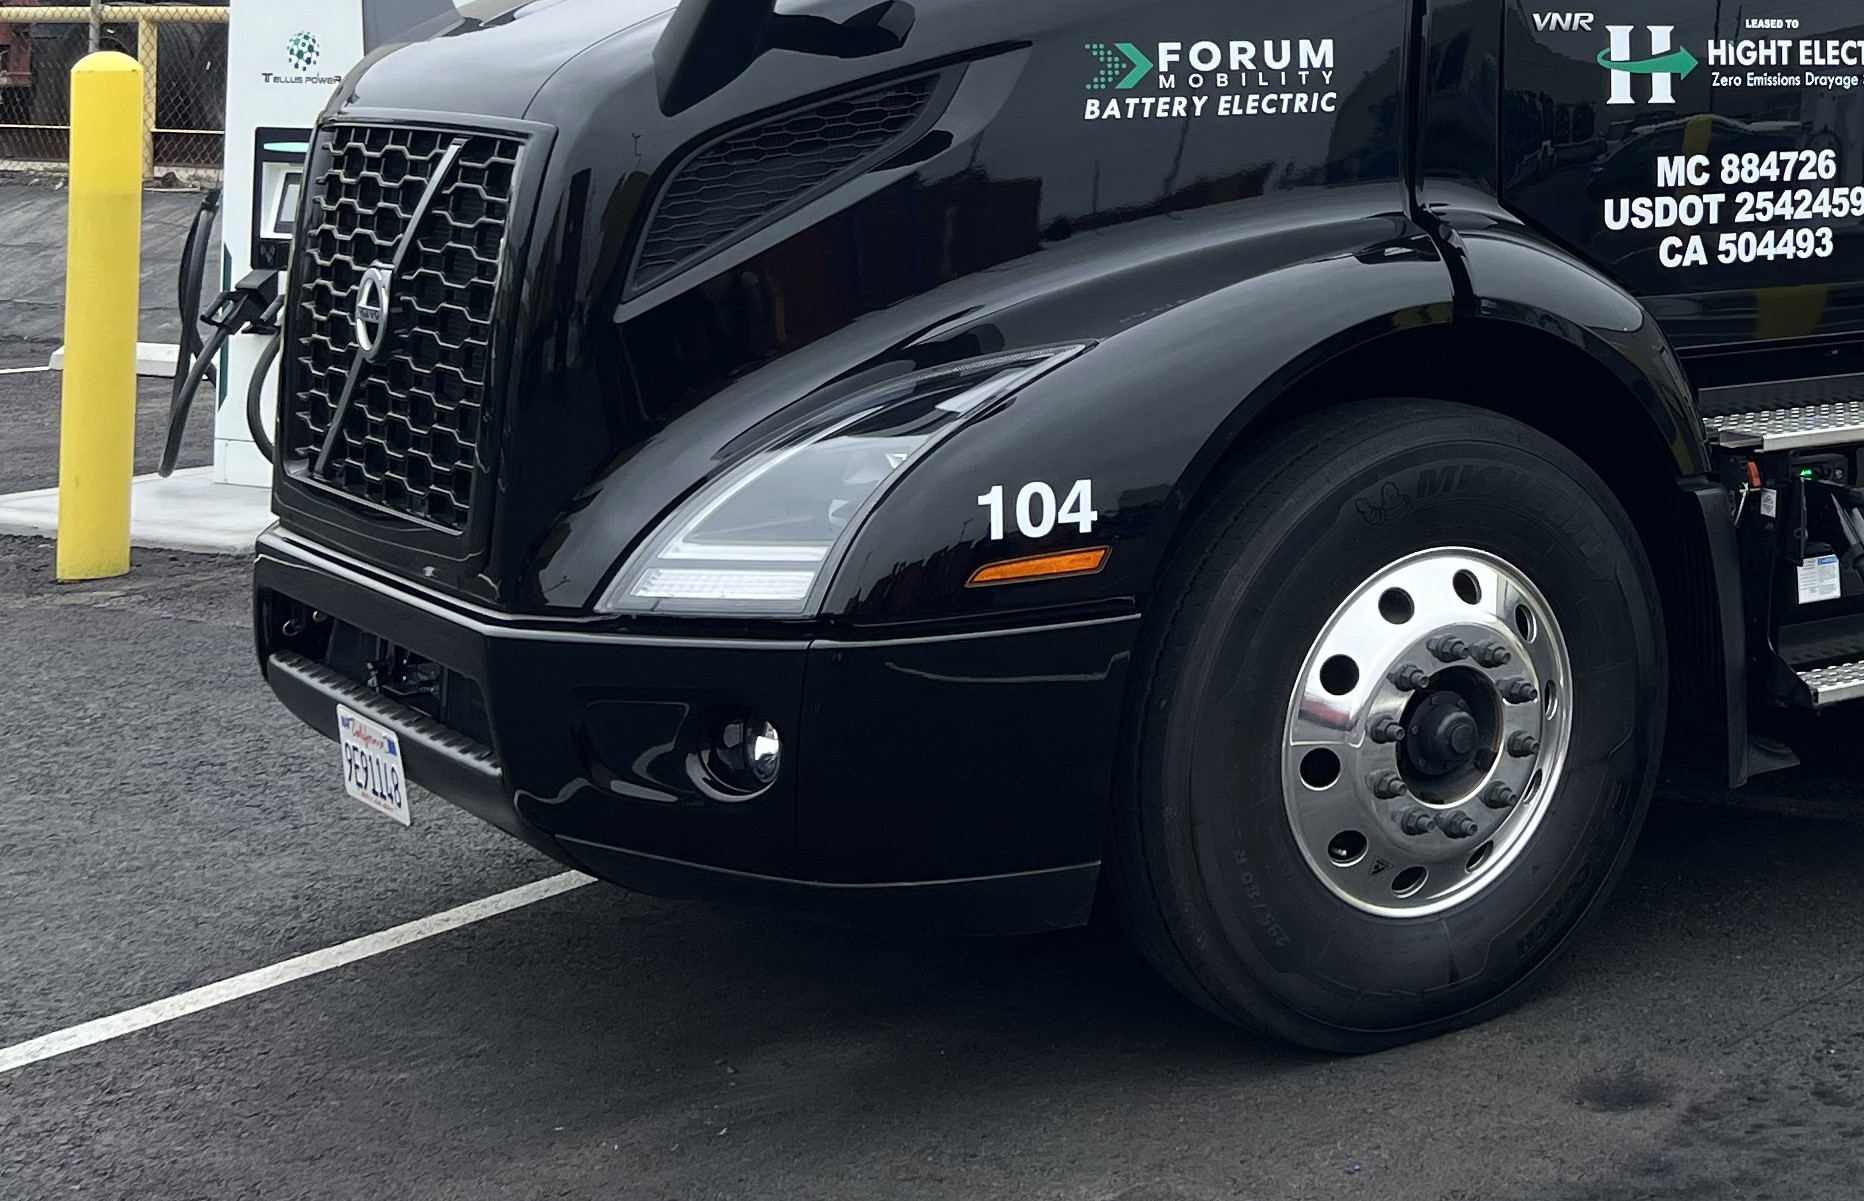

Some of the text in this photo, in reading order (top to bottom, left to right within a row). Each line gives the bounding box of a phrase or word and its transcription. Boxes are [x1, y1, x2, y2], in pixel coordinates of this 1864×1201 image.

[1532, 12, 1595, 32] VNR
[1745, 19, 1799, 30] LEASED TO
[1158, 39, 1334, 72] FORUM
[1707, 39, 1793, 67] HIGHT
[1159, 71, 1333, 88] MOBILITY
[1711, 73, 1742, 88] Zero
[1746, 73, 1800, 88] Emissions
[1805, 72, 1859, 90] Drayage
[1084, 92, 1337, 120] BATTERY ELECTRIC
[1657, 149, 1837, 187] MC 884726
[1604, 194, 1725, 230] USDOT
[1659, 227, 1834, 268] CA 504493
[977, 478, 1098, 541] 104
